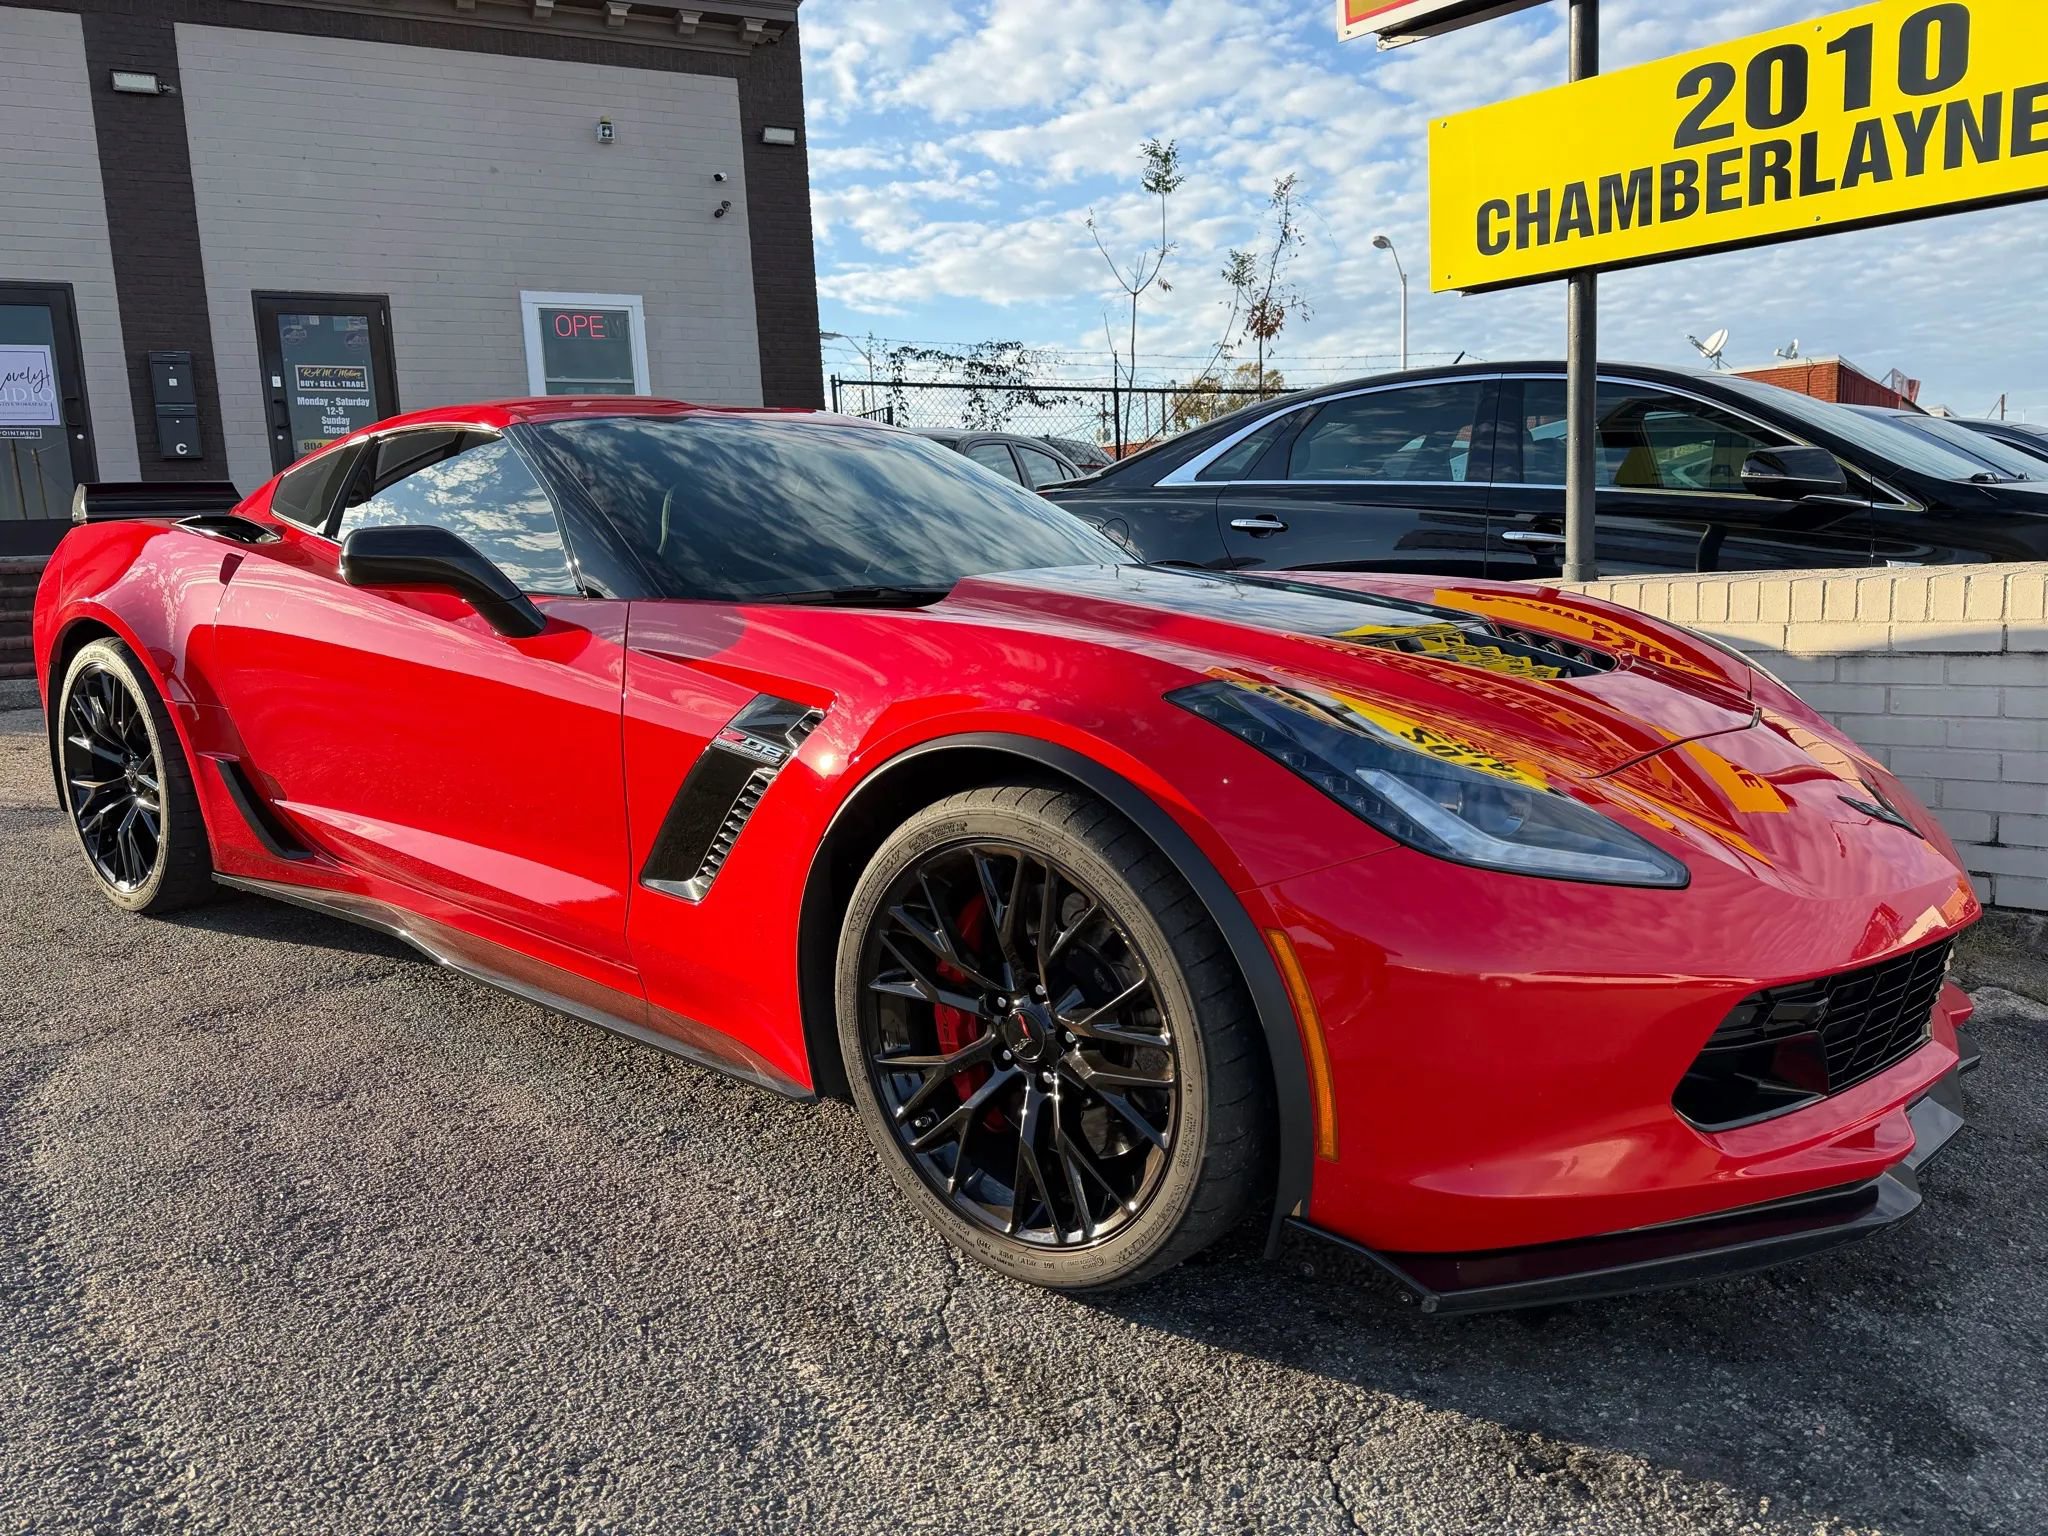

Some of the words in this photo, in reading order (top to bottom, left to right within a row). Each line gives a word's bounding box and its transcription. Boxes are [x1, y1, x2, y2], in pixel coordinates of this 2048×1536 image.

[1673, 3, 1971, 149] 2010
[1476, 81, 2048, 256] CHAMBERLAYNE
[297, 397, 328, 406] Monday
[336, 398, 370, 407] Saturday
[326, 407, 344, 415] 12-5
[321, 416, 350, 425] Sunday
[324, 426, 350, 434] Closed
[176, 443, 187, 454] C
